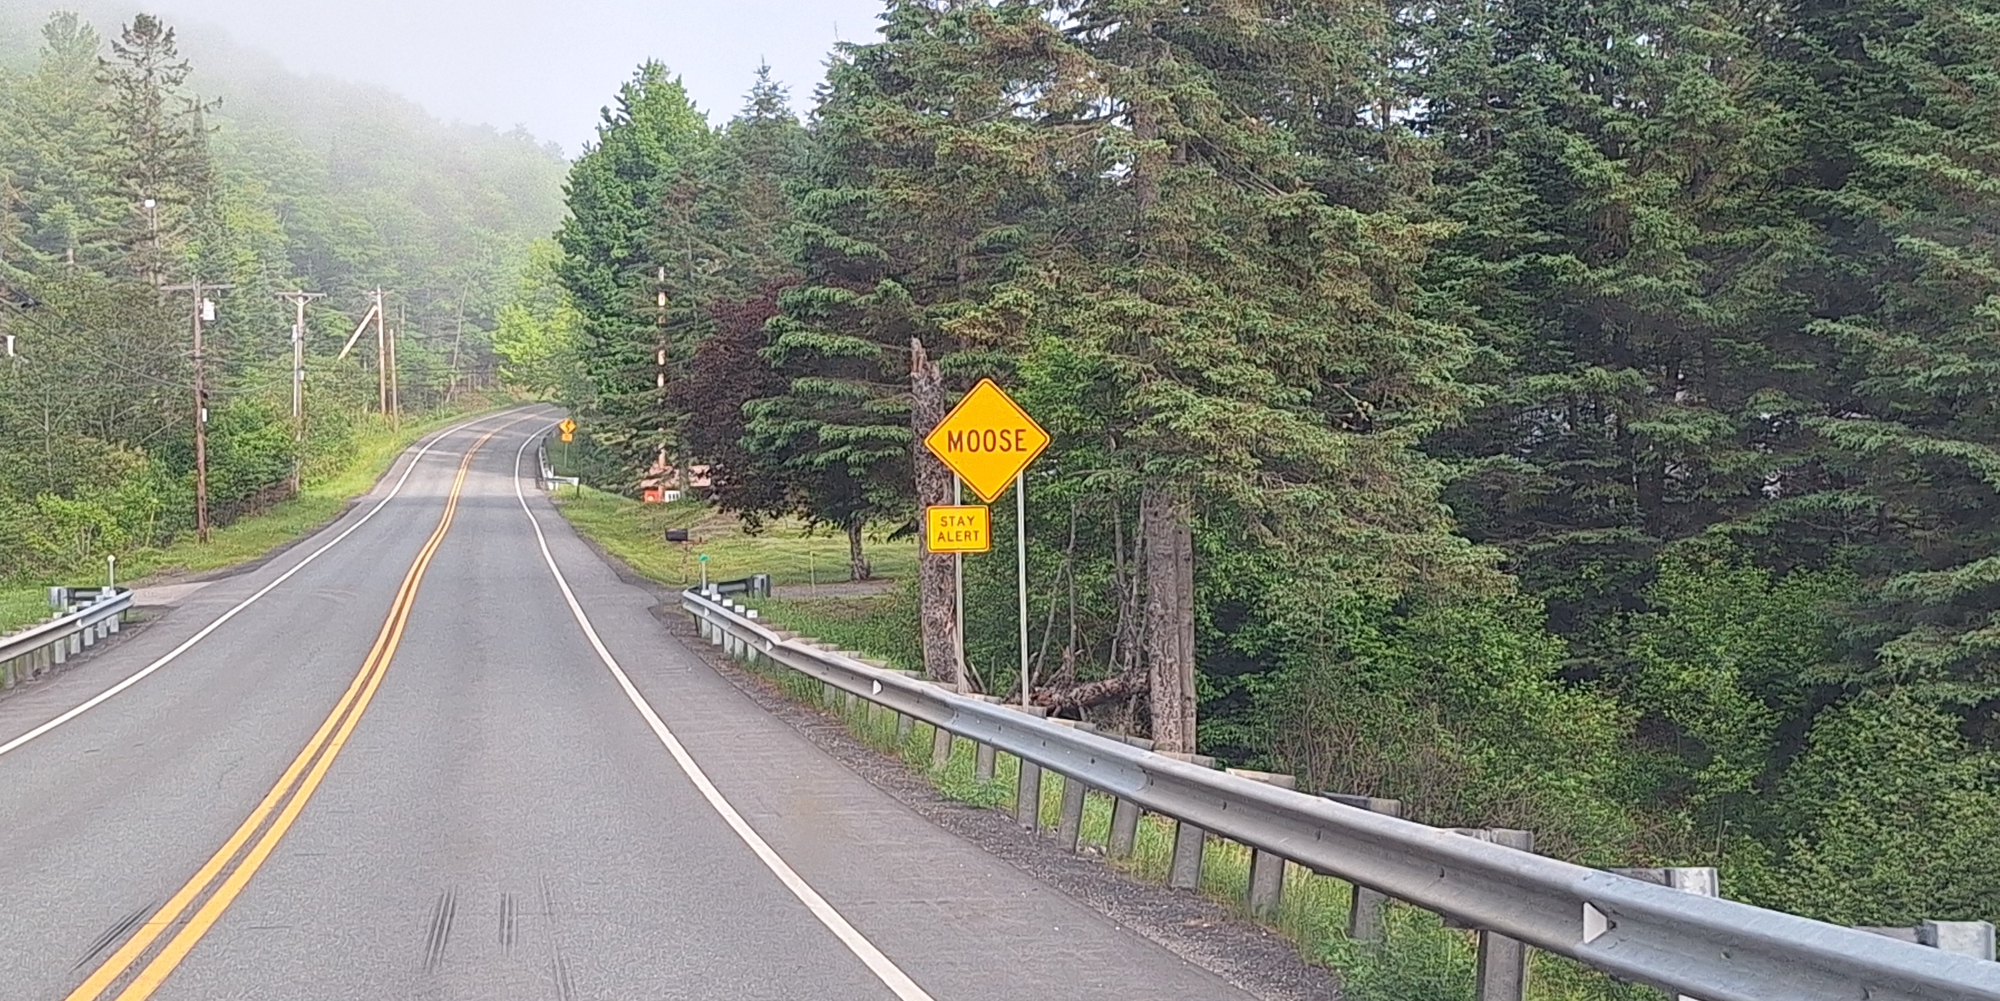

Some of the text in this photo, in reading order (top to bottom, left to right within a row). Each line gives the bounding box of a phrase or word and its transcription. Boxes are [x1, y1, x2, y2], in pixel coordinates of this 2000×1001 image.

[947, 429, 1027, 453] MOOSE
[940, 516, 975, 527] STAY
[937, 530, 980, 542] ALERT
